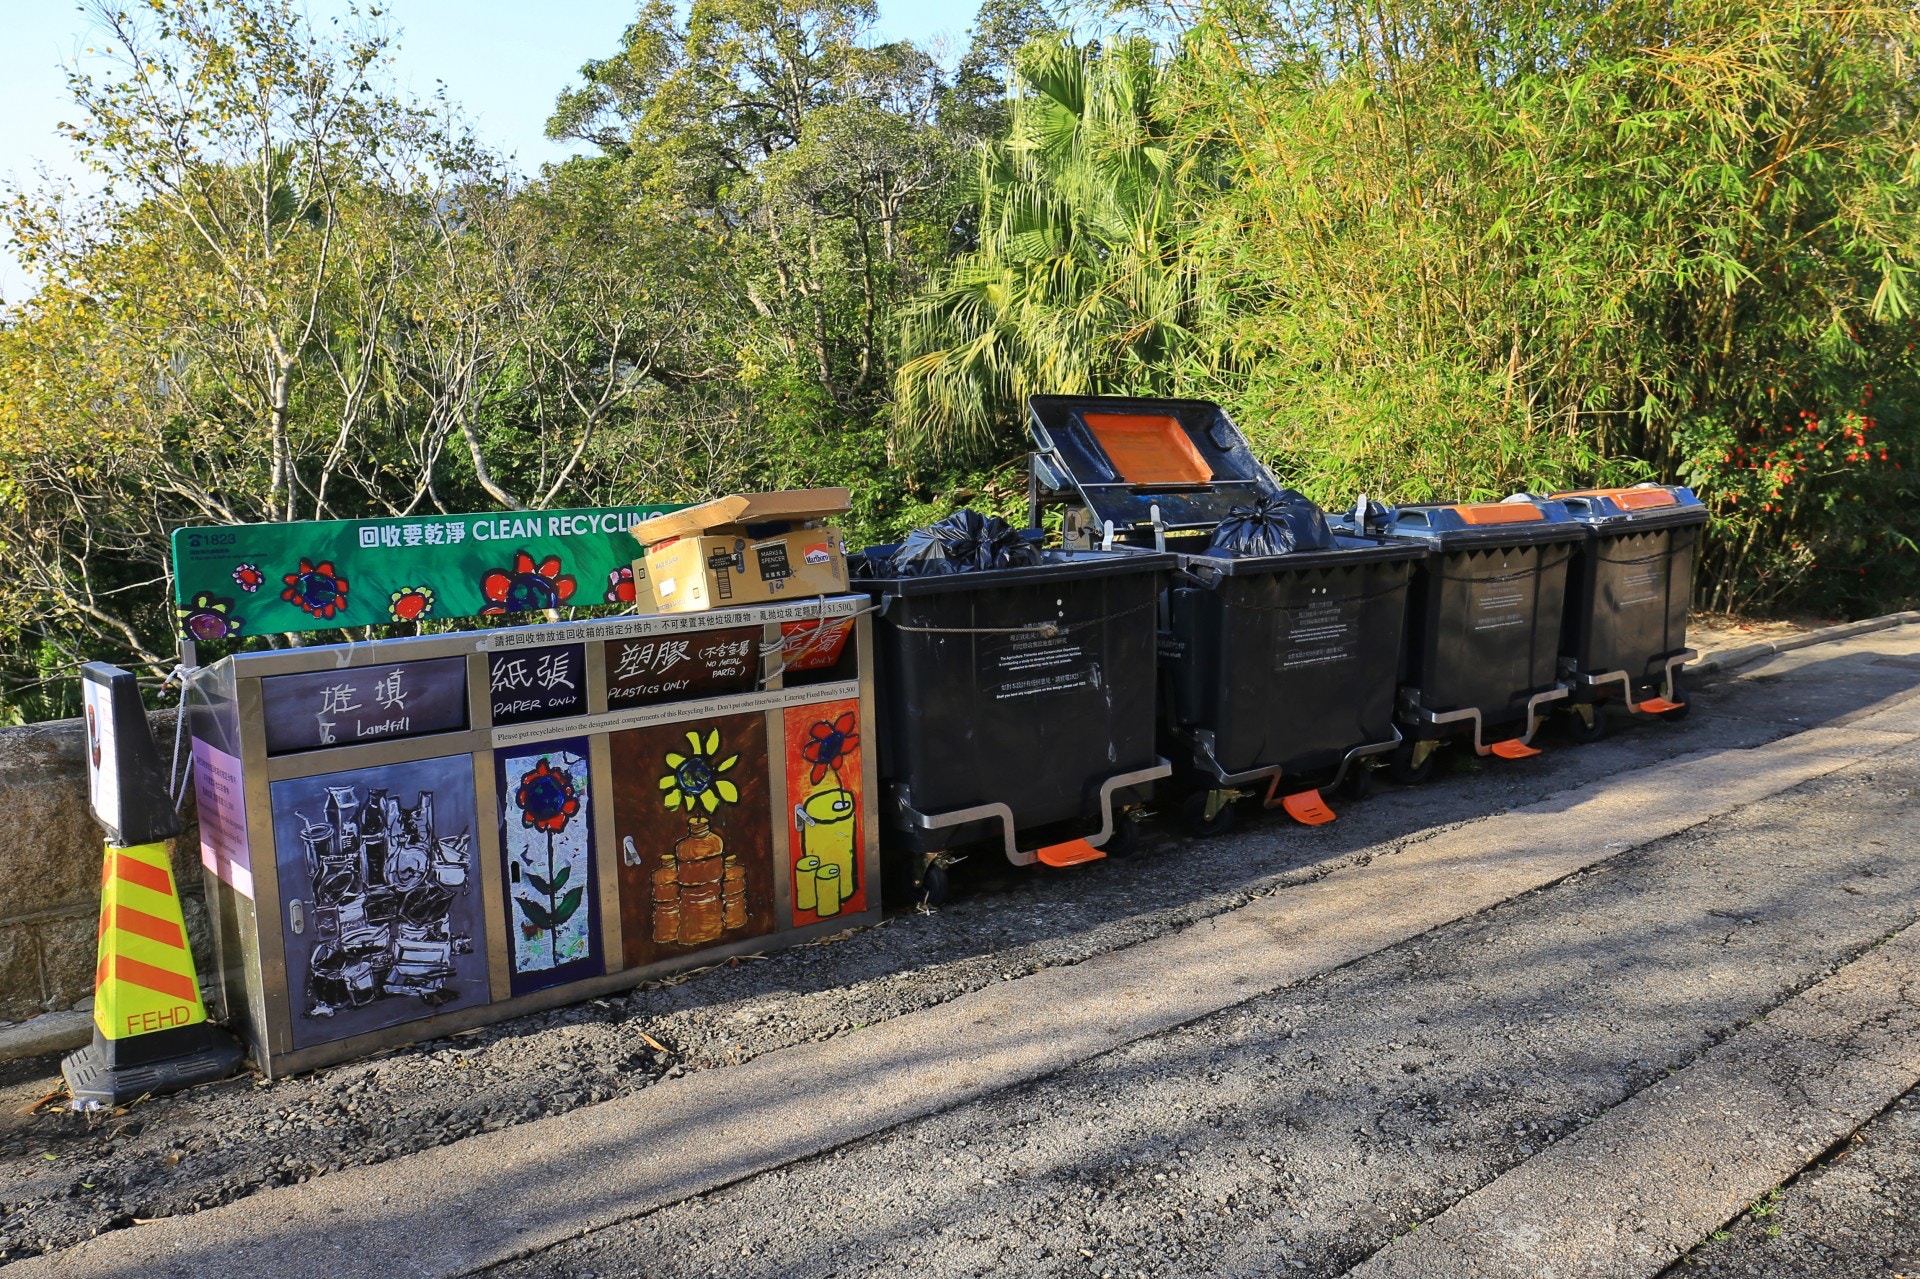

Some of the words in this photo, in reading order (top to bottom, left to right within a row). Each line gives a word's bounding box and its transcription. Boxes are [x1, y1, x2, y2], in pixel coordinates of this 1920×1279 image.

[203, 533, 236, 545] 1823
[359, 522, 465, 548] 回收要乾淨
[473, 517, 542, 541] CLEAN
[761, 556, 786, 564] SPENCER
[806, 554, 829, 564] Marlboro
[490, 652, 575, 693] 紙張
[614, 641, 691, 680] 塑膠
[719, 657, 742, 667] METAL
[319, 669, 408, 714] 堆填
[608, 685, 659, 699] PLASTICS
[663, 679, 690, 690] ONLY
[494, 699, 541, 718] PAPER
[548, 696, 578, 707] ONLY
[497, 732, 517, 741] Please
[518, 731, 529, 739] put
[530, 726, 564, 737] recyclables
[588, 718, 619, 729] designated
[621, 713, 660, 724] compartments
[677, 706, 704, 716] Recycling
[717, 702, 732, 710] Don't
[784, 694, 806, 702] Littering
[820, 689, 838, 697] Penalty
[321, 722, 336, 744] To
[357, 717, 410, 737] Landfill
[127, 1005, 191, 1035] FEHD
